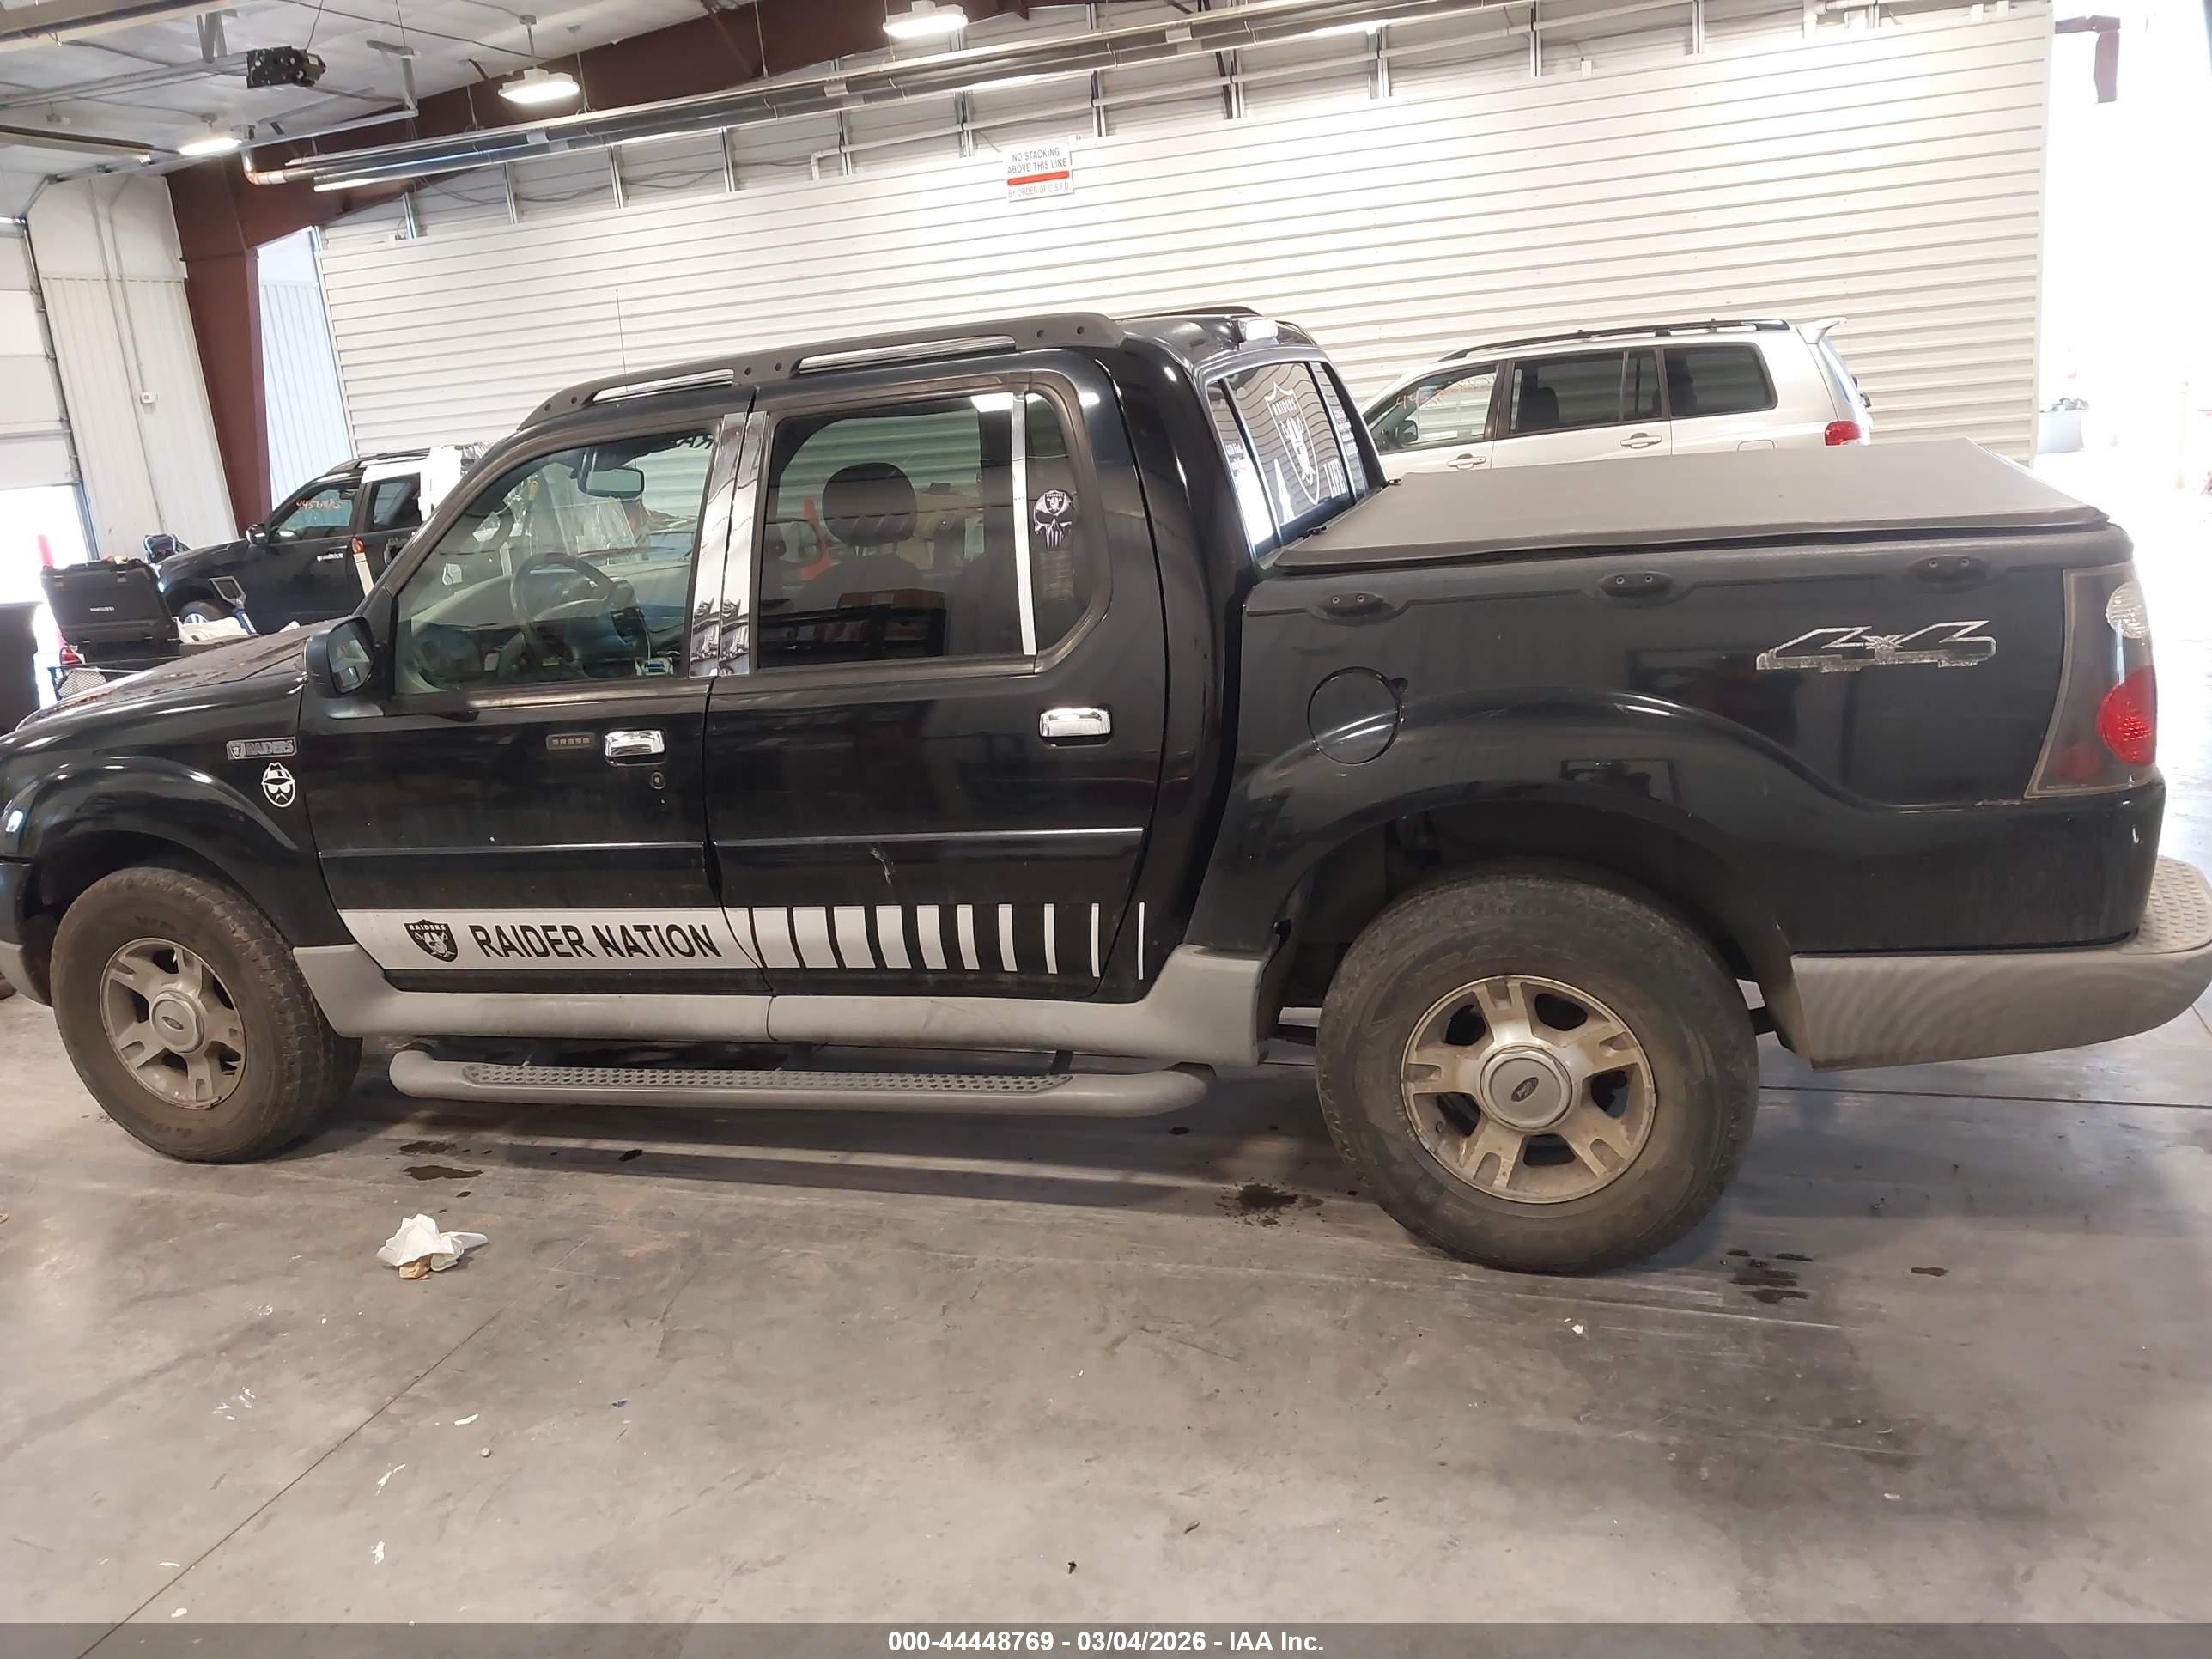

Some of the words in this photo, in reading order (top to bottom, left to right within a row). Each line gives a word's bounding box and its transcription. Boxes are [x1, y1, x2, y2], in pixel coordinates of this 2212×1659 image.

[1012, 152, 1023, 162] NO
[1024, 147, 1060, 161] STACKING
[1007, 162, 1031, 174] ABOVE
[1033, 161, 1049, 171] THIS
[1051, 157, 1067, 168] LINE
[468, 925, 598, 957] RAIDER
[592, 925, 723, 957] NATION
